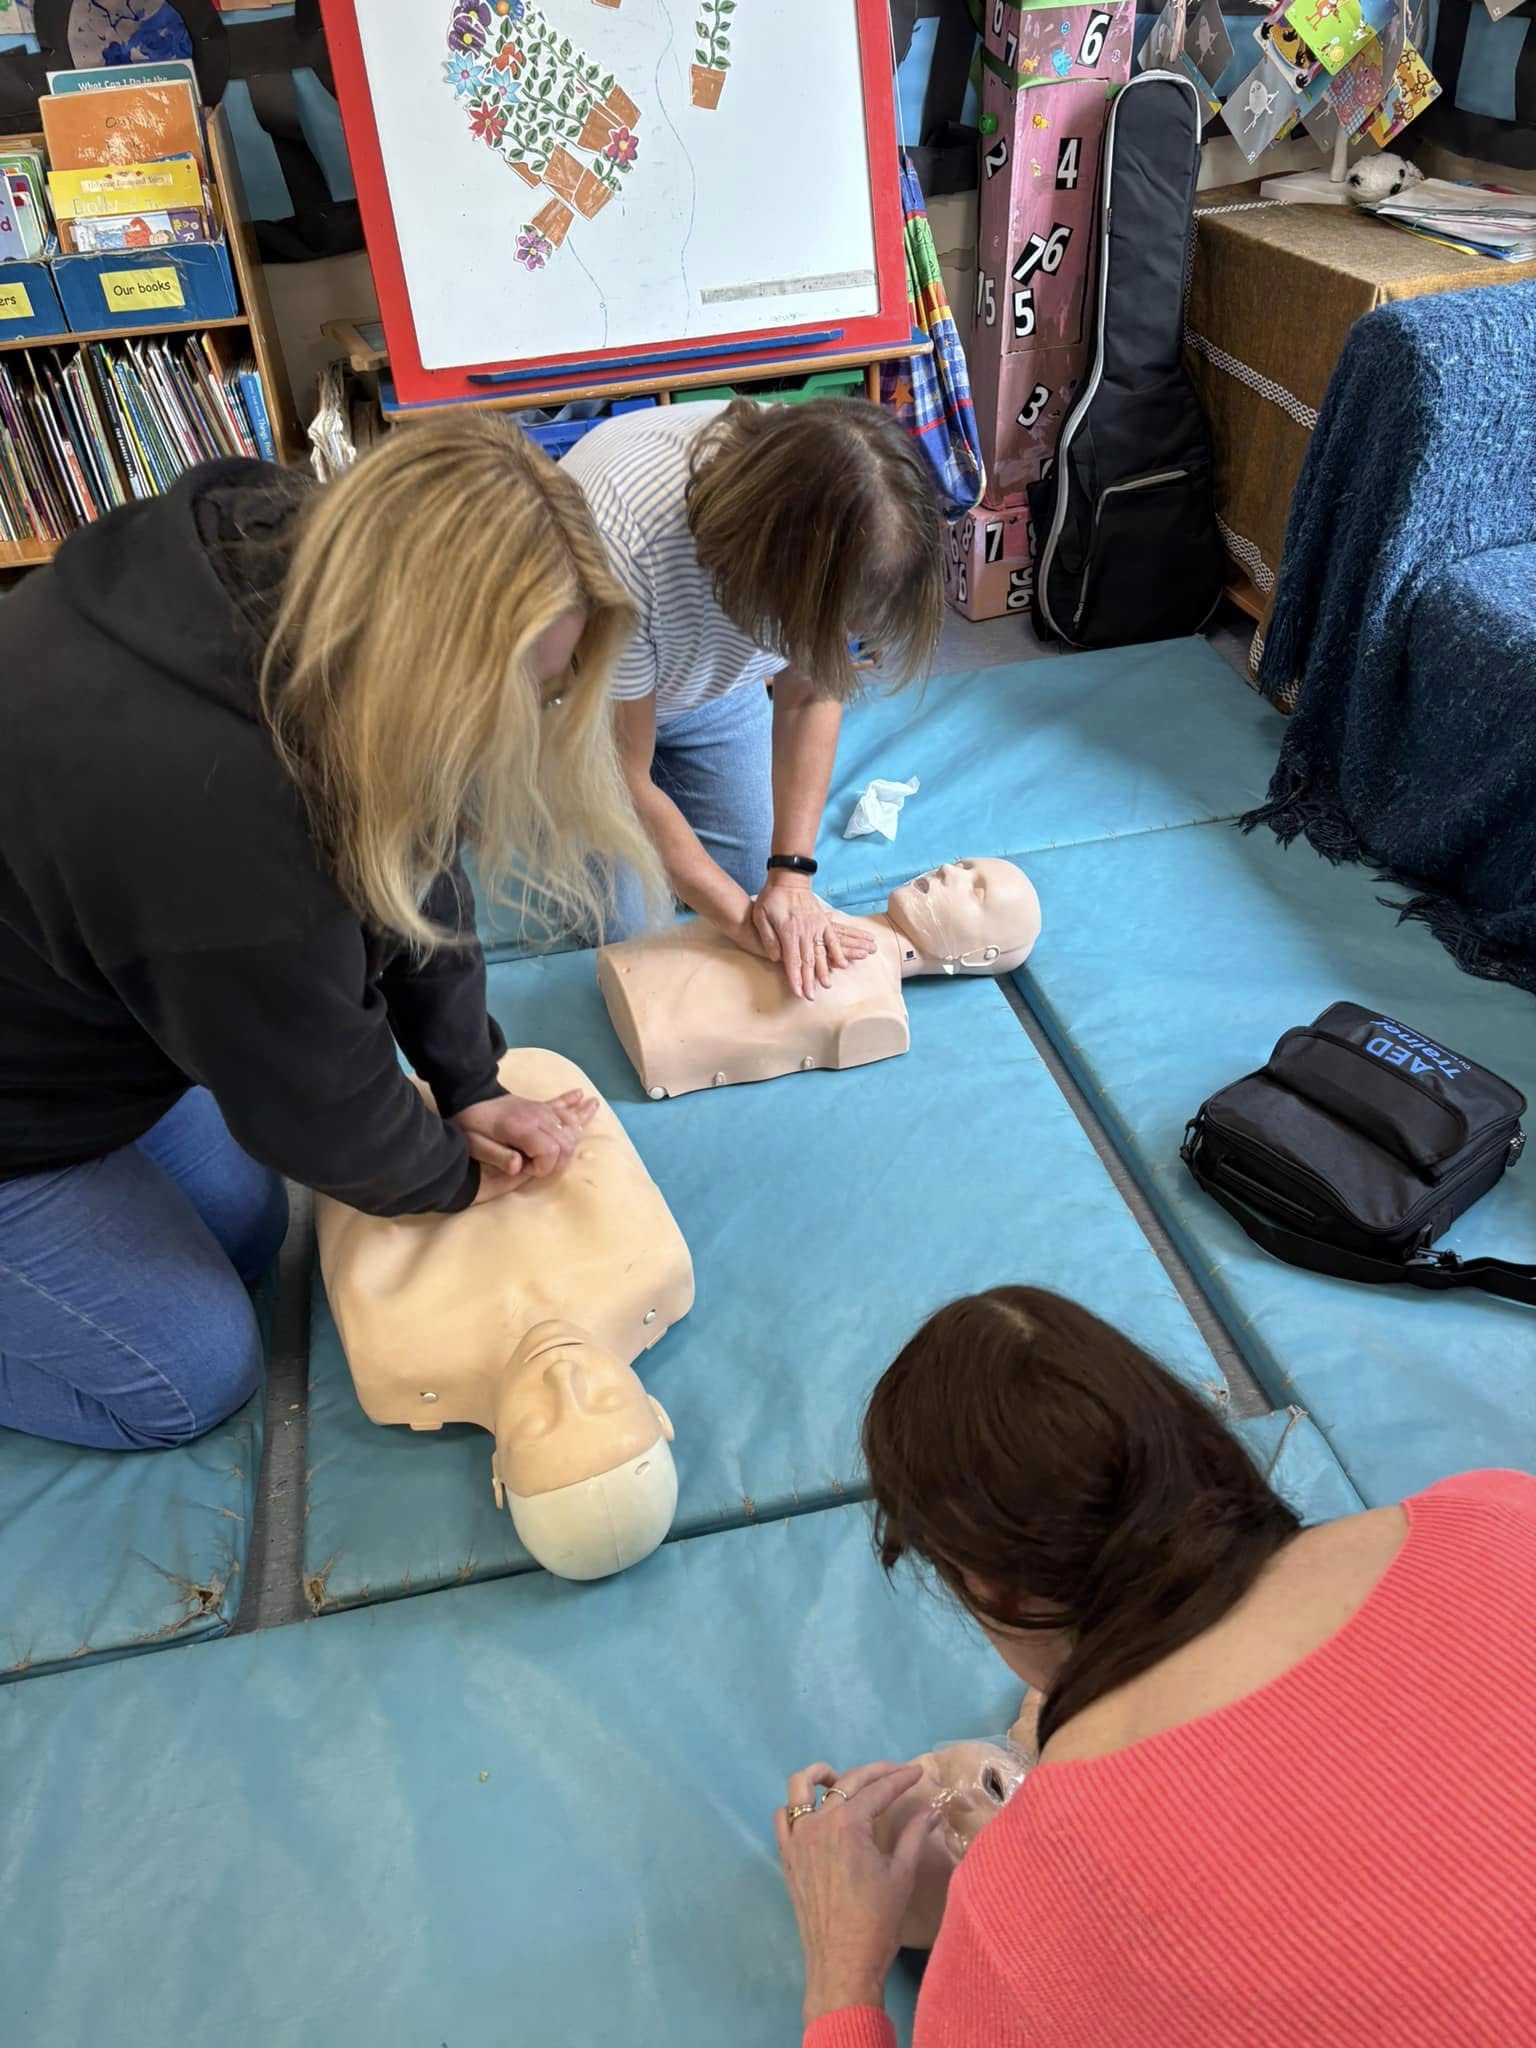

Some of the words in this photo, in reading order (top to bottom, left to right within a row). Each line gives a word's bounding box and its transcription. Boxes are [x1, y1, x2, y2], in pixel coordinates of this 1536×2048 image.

[1080, 13, 1110, 65] 6
[78, 81, 102, 92] What
[984, 144, 1007, 178] 2
[1057, 138, 1079, 188] 4
[113, 284, 135, 297] Our
[137, 279, 171, 294] books
[1014, 289, 1035, 337] 5
[1017, 386, 1050, 427] 3
[986, 522, 1004, 562] 7
[1365, 1037, 1435, 1074] AED
[1370, 1020, 1461, 1080] Trainer
